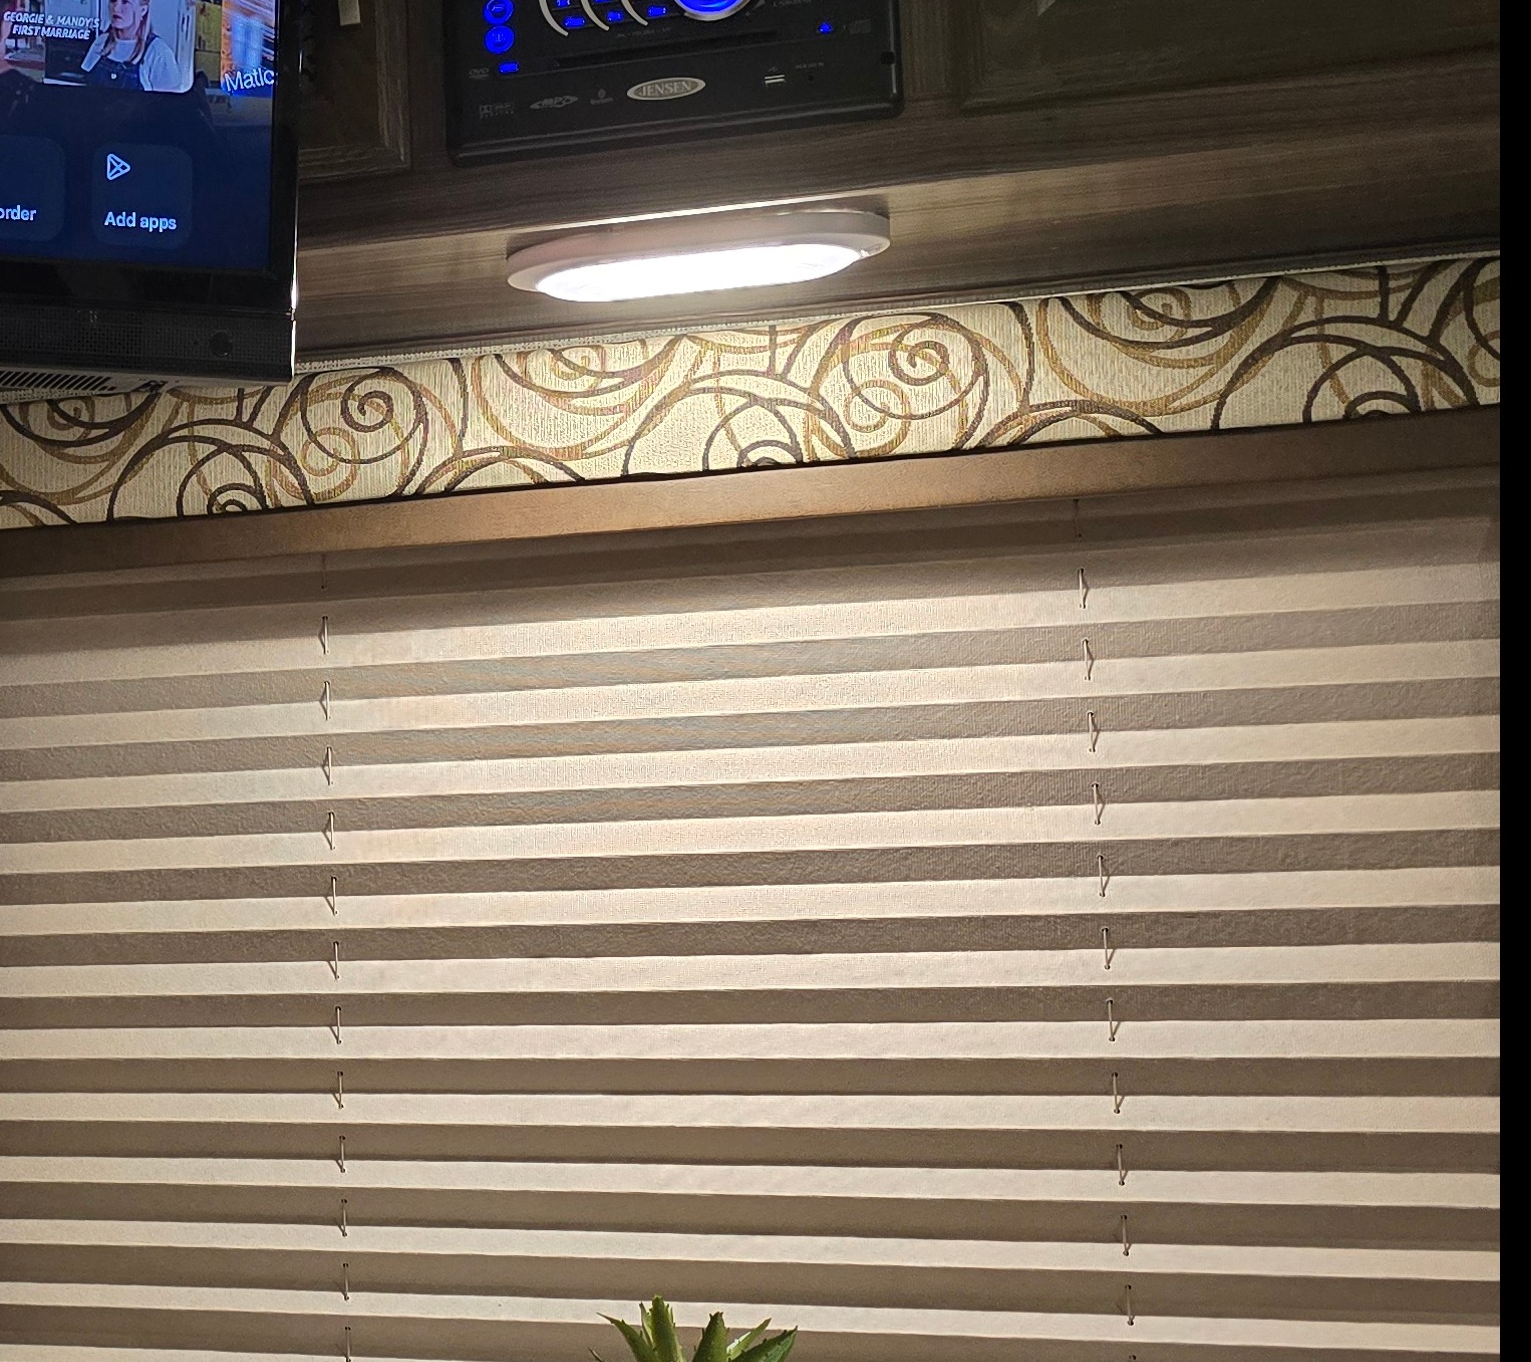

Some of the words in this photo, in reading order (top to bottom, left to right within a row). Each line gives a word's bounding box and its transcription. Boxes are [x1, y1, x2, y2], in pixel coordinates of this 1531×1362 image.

[3, 10, 45, 24] GEORGIE
[45, 14, 55, 25] &
[56, 15, 100, 28] MANDY'S
[12, 24, 41, 37] FIRST
[41, 25, 91, 40] MARRIAGE
[637, 80, 693, 99] JENSEN
[104, 211, 138, 229] Add
[139, 213, 177, 233] apps
